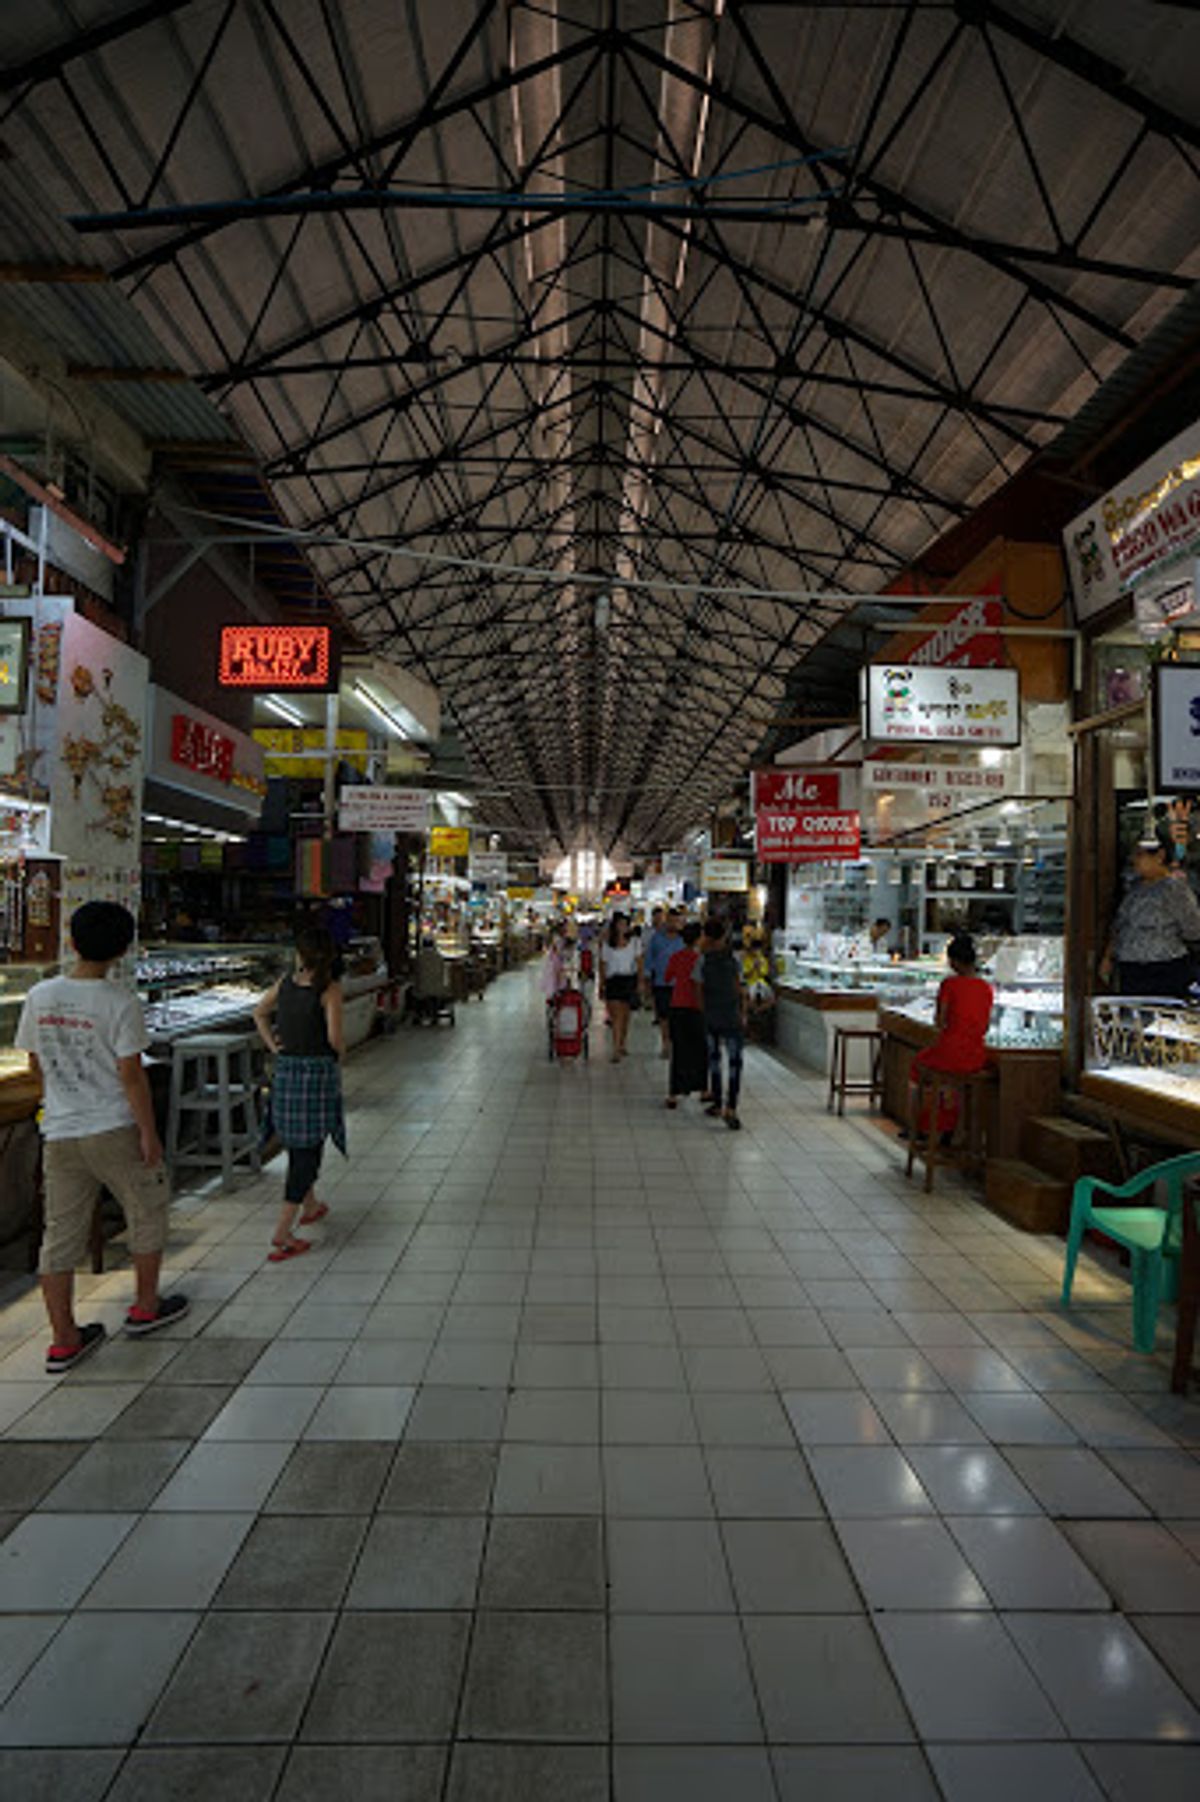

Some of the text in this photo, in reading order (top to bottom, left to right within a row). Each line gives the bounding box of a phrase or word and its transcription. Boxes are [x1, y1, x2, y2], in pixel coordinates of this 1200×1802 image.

[232, 637, 315, 660] RUBY
[774, 776, 821, 801] Me
[767, 815, 853, 833] TOP CHOICE
